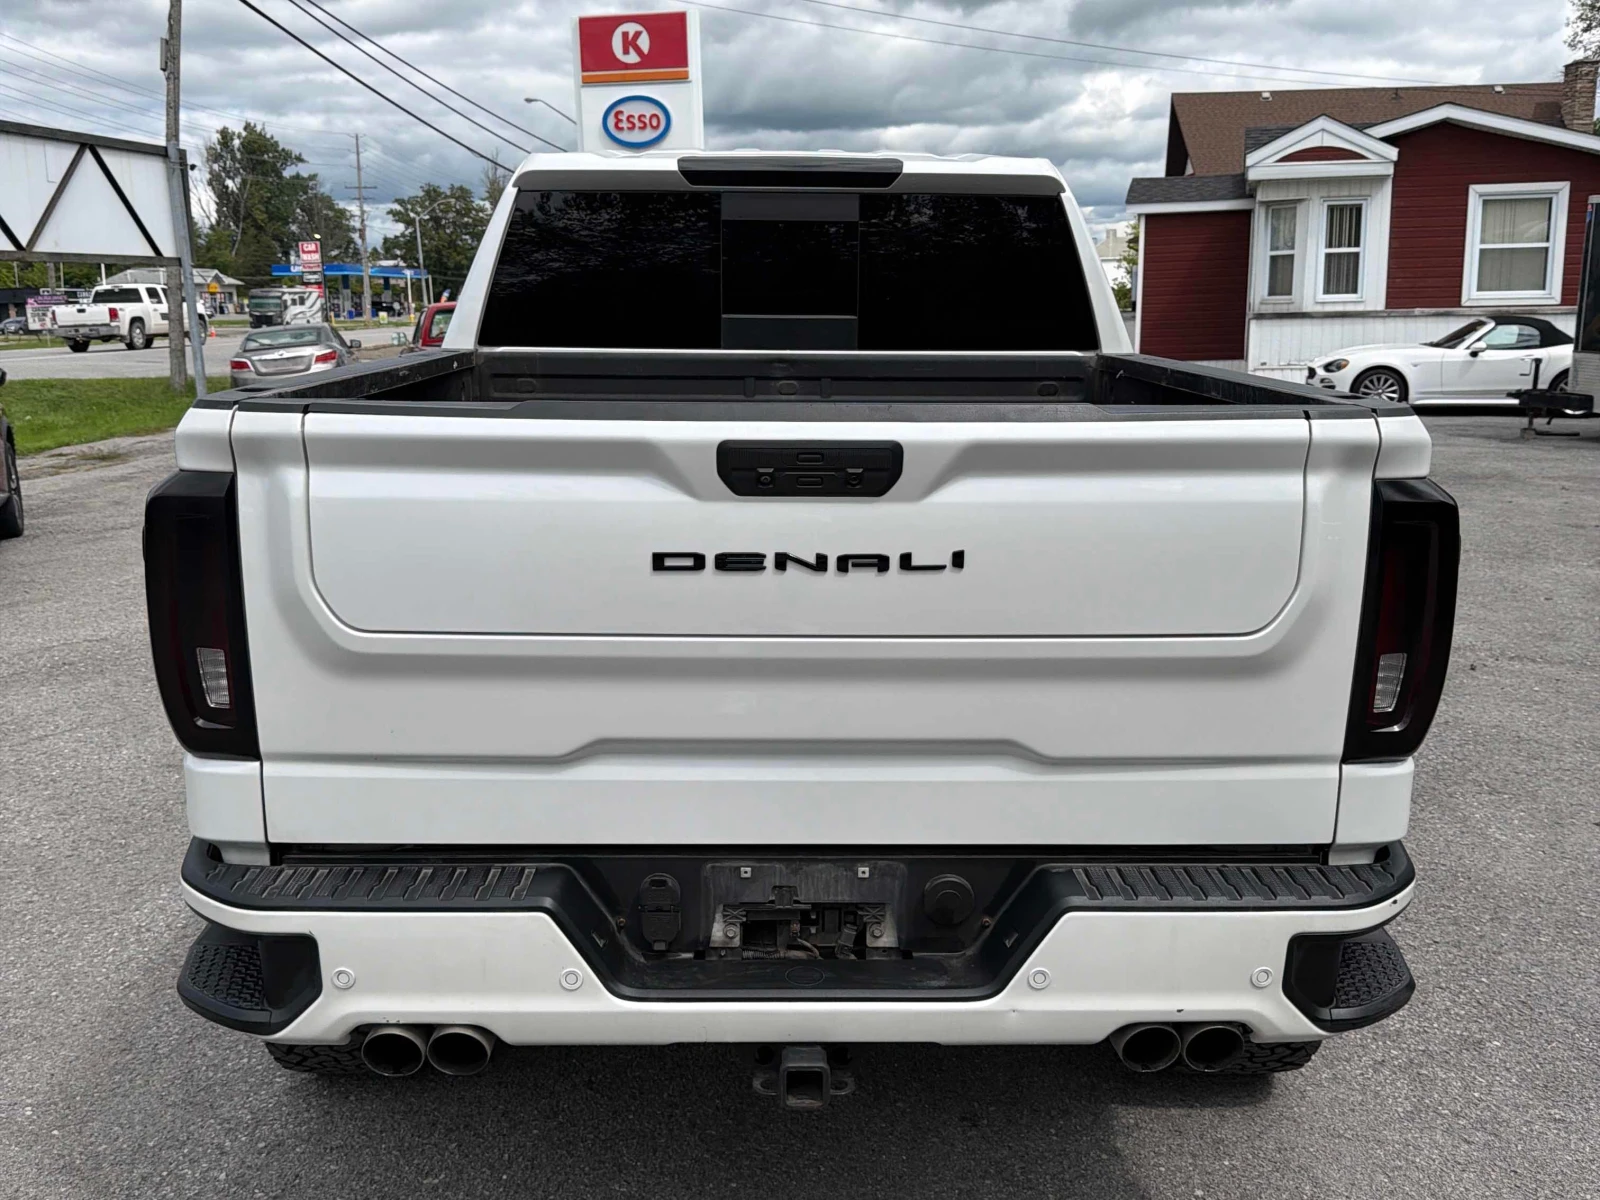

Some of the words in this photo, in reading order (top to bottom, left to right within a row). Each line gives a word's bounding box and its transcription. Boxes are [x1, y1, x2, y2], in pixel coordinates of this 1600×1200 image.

[620, 29, 648, 61] K
[613, 109, 662, 132] Esso
[652, 549, 965, 573] DENALI
